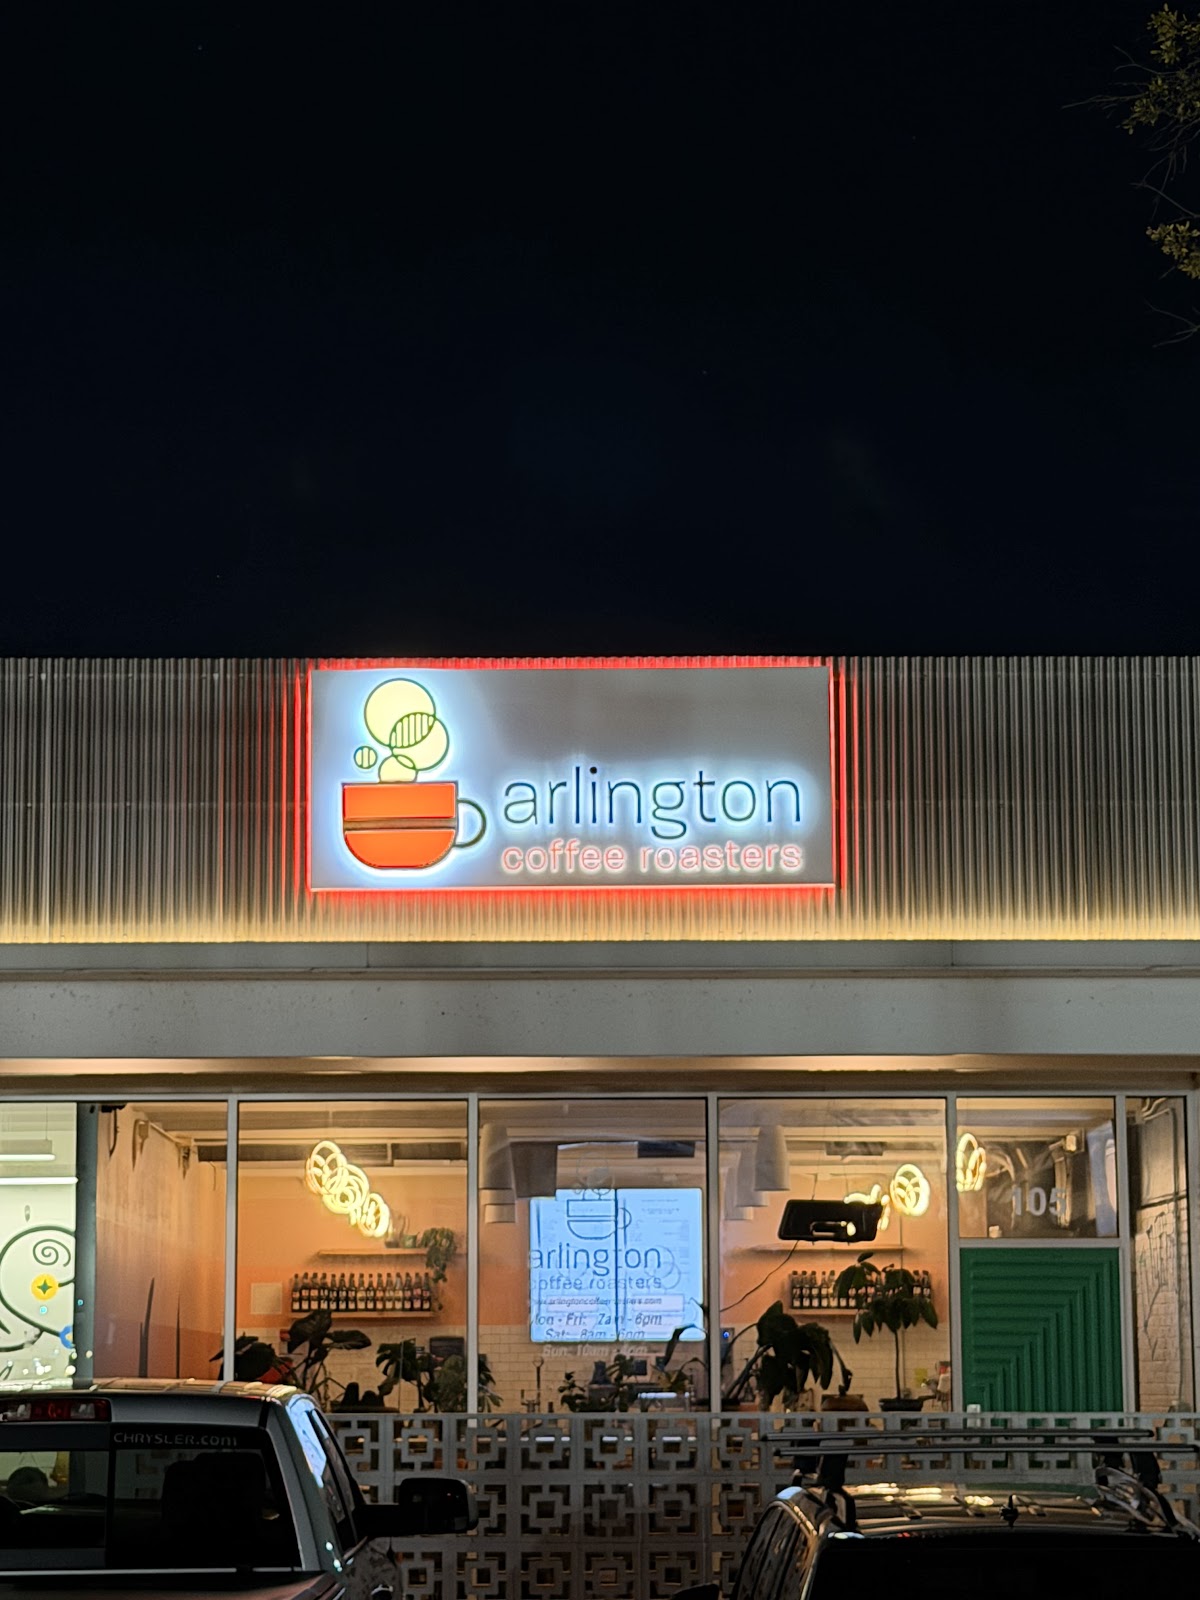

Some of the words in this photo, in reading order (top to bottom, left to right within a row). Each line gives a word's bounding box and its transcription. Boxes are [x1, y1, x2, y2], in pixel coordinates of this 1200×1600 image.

[503, 766, 801, 840] arlington
[502, 839, 625, 871] coffee
[639, 841, 802, 871] roasters
[1013, 1186, 1067, 1216] 105
[528, 1242, 662, 1276] arlington
[635, 1313, 663, 1327] 6pm
[113, 1432, 238, 1447] CHRYSLER.com
